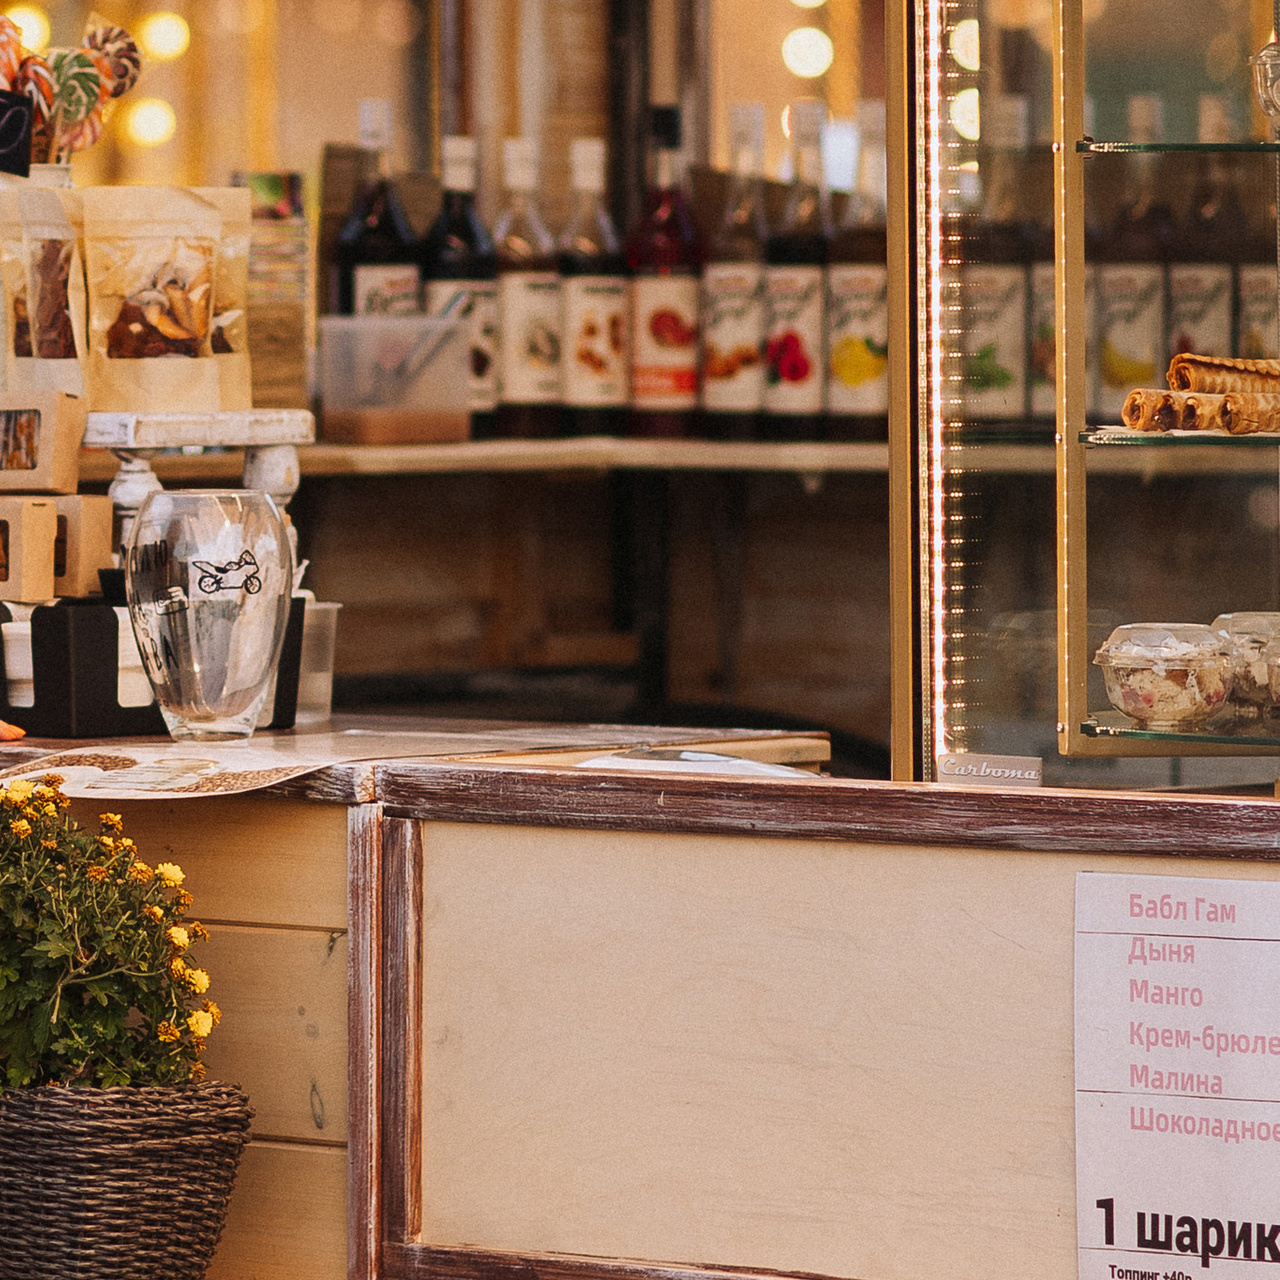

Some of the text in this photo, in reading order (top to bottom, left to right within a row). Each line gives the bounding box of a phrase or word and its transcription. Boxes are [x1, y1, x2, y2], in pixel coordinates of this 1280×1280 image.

[941, 758, 1039, 780] Carboma
[1129, 893, 1237, 924] Бабл Гам
[1128, 936, 1196, 965] Дыня
[1129, 979, 1204, 1007] Манго
[1129, 1022, 1280, 1056] Крем-брюле
[1129, 1064, 1224, 1094] Малина
[1129, 1106, 1280, 1144] Шоколадное
[1096, 1197, 1280, 1268] 1 шарик
